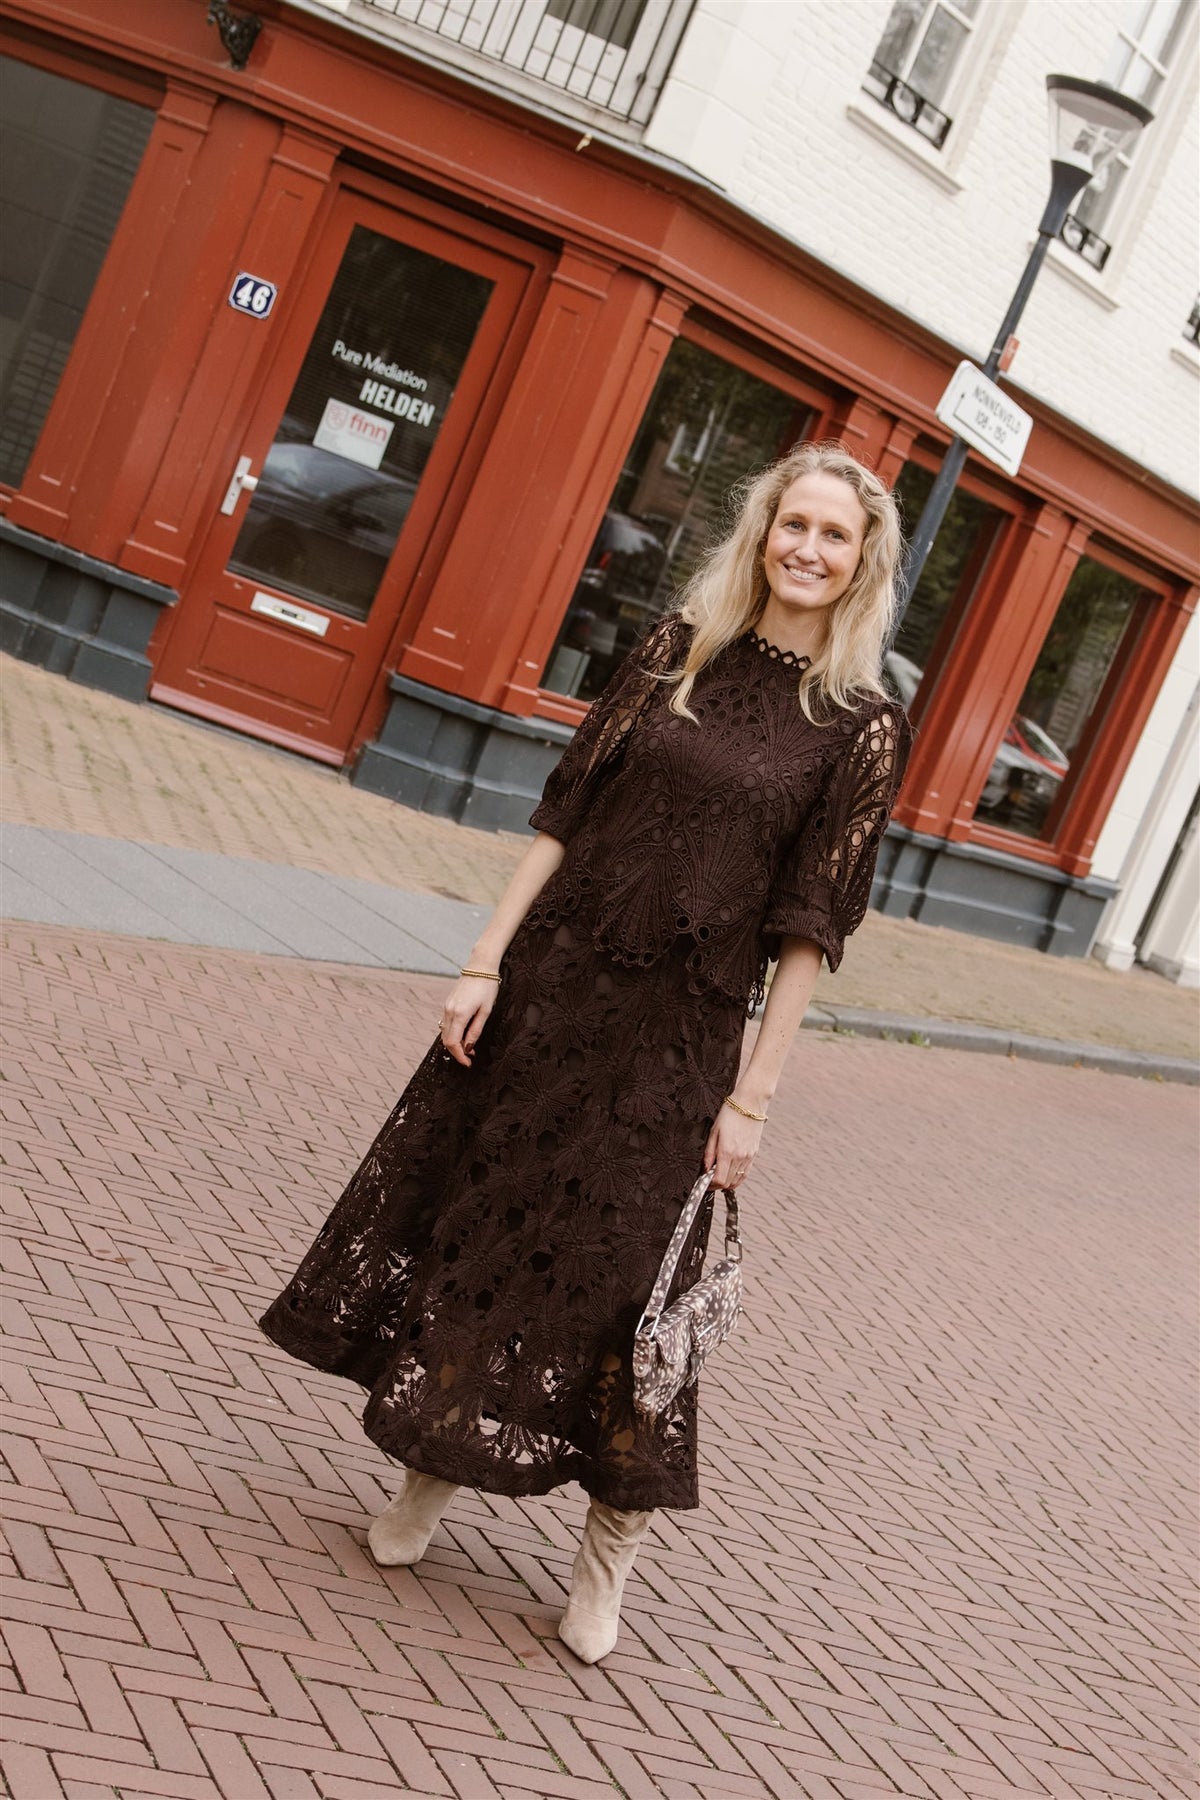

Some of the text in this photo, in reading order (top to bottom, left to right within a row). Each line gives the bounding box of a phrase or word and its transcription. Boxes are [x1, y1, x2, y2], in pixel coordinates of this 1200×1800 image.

[236, 280, 271, 313] 46
[332, 339, 428, 392] Pure Mediation
[359, 379, 435, 427] HELDEN
[350, 413, 388, 442] finn
